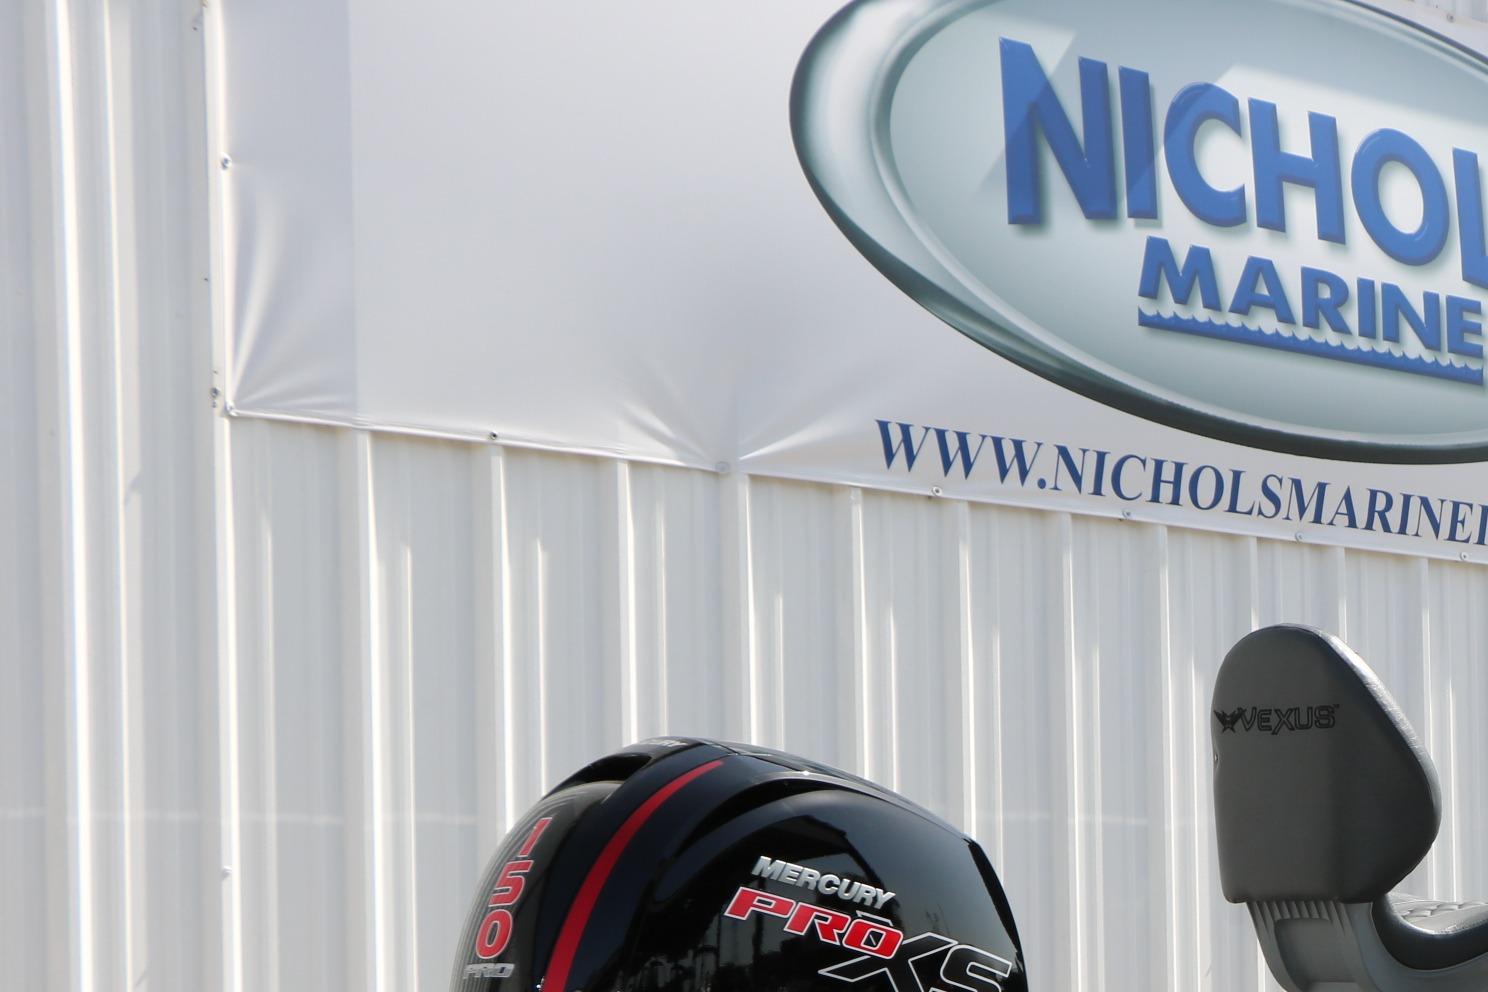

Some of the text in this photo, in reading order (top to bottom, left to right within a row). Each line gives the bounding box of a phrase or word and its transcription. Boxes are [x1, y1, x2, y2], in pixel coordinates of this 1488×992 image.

[1137, 235, 1484, 359] MARINE
[1238, 704, 1337, 735] VEXUS
[475, 816, 553, 960] 150
[751, 855, 896, 910] MERCURY
[723, 885, 904, 960] PRO
